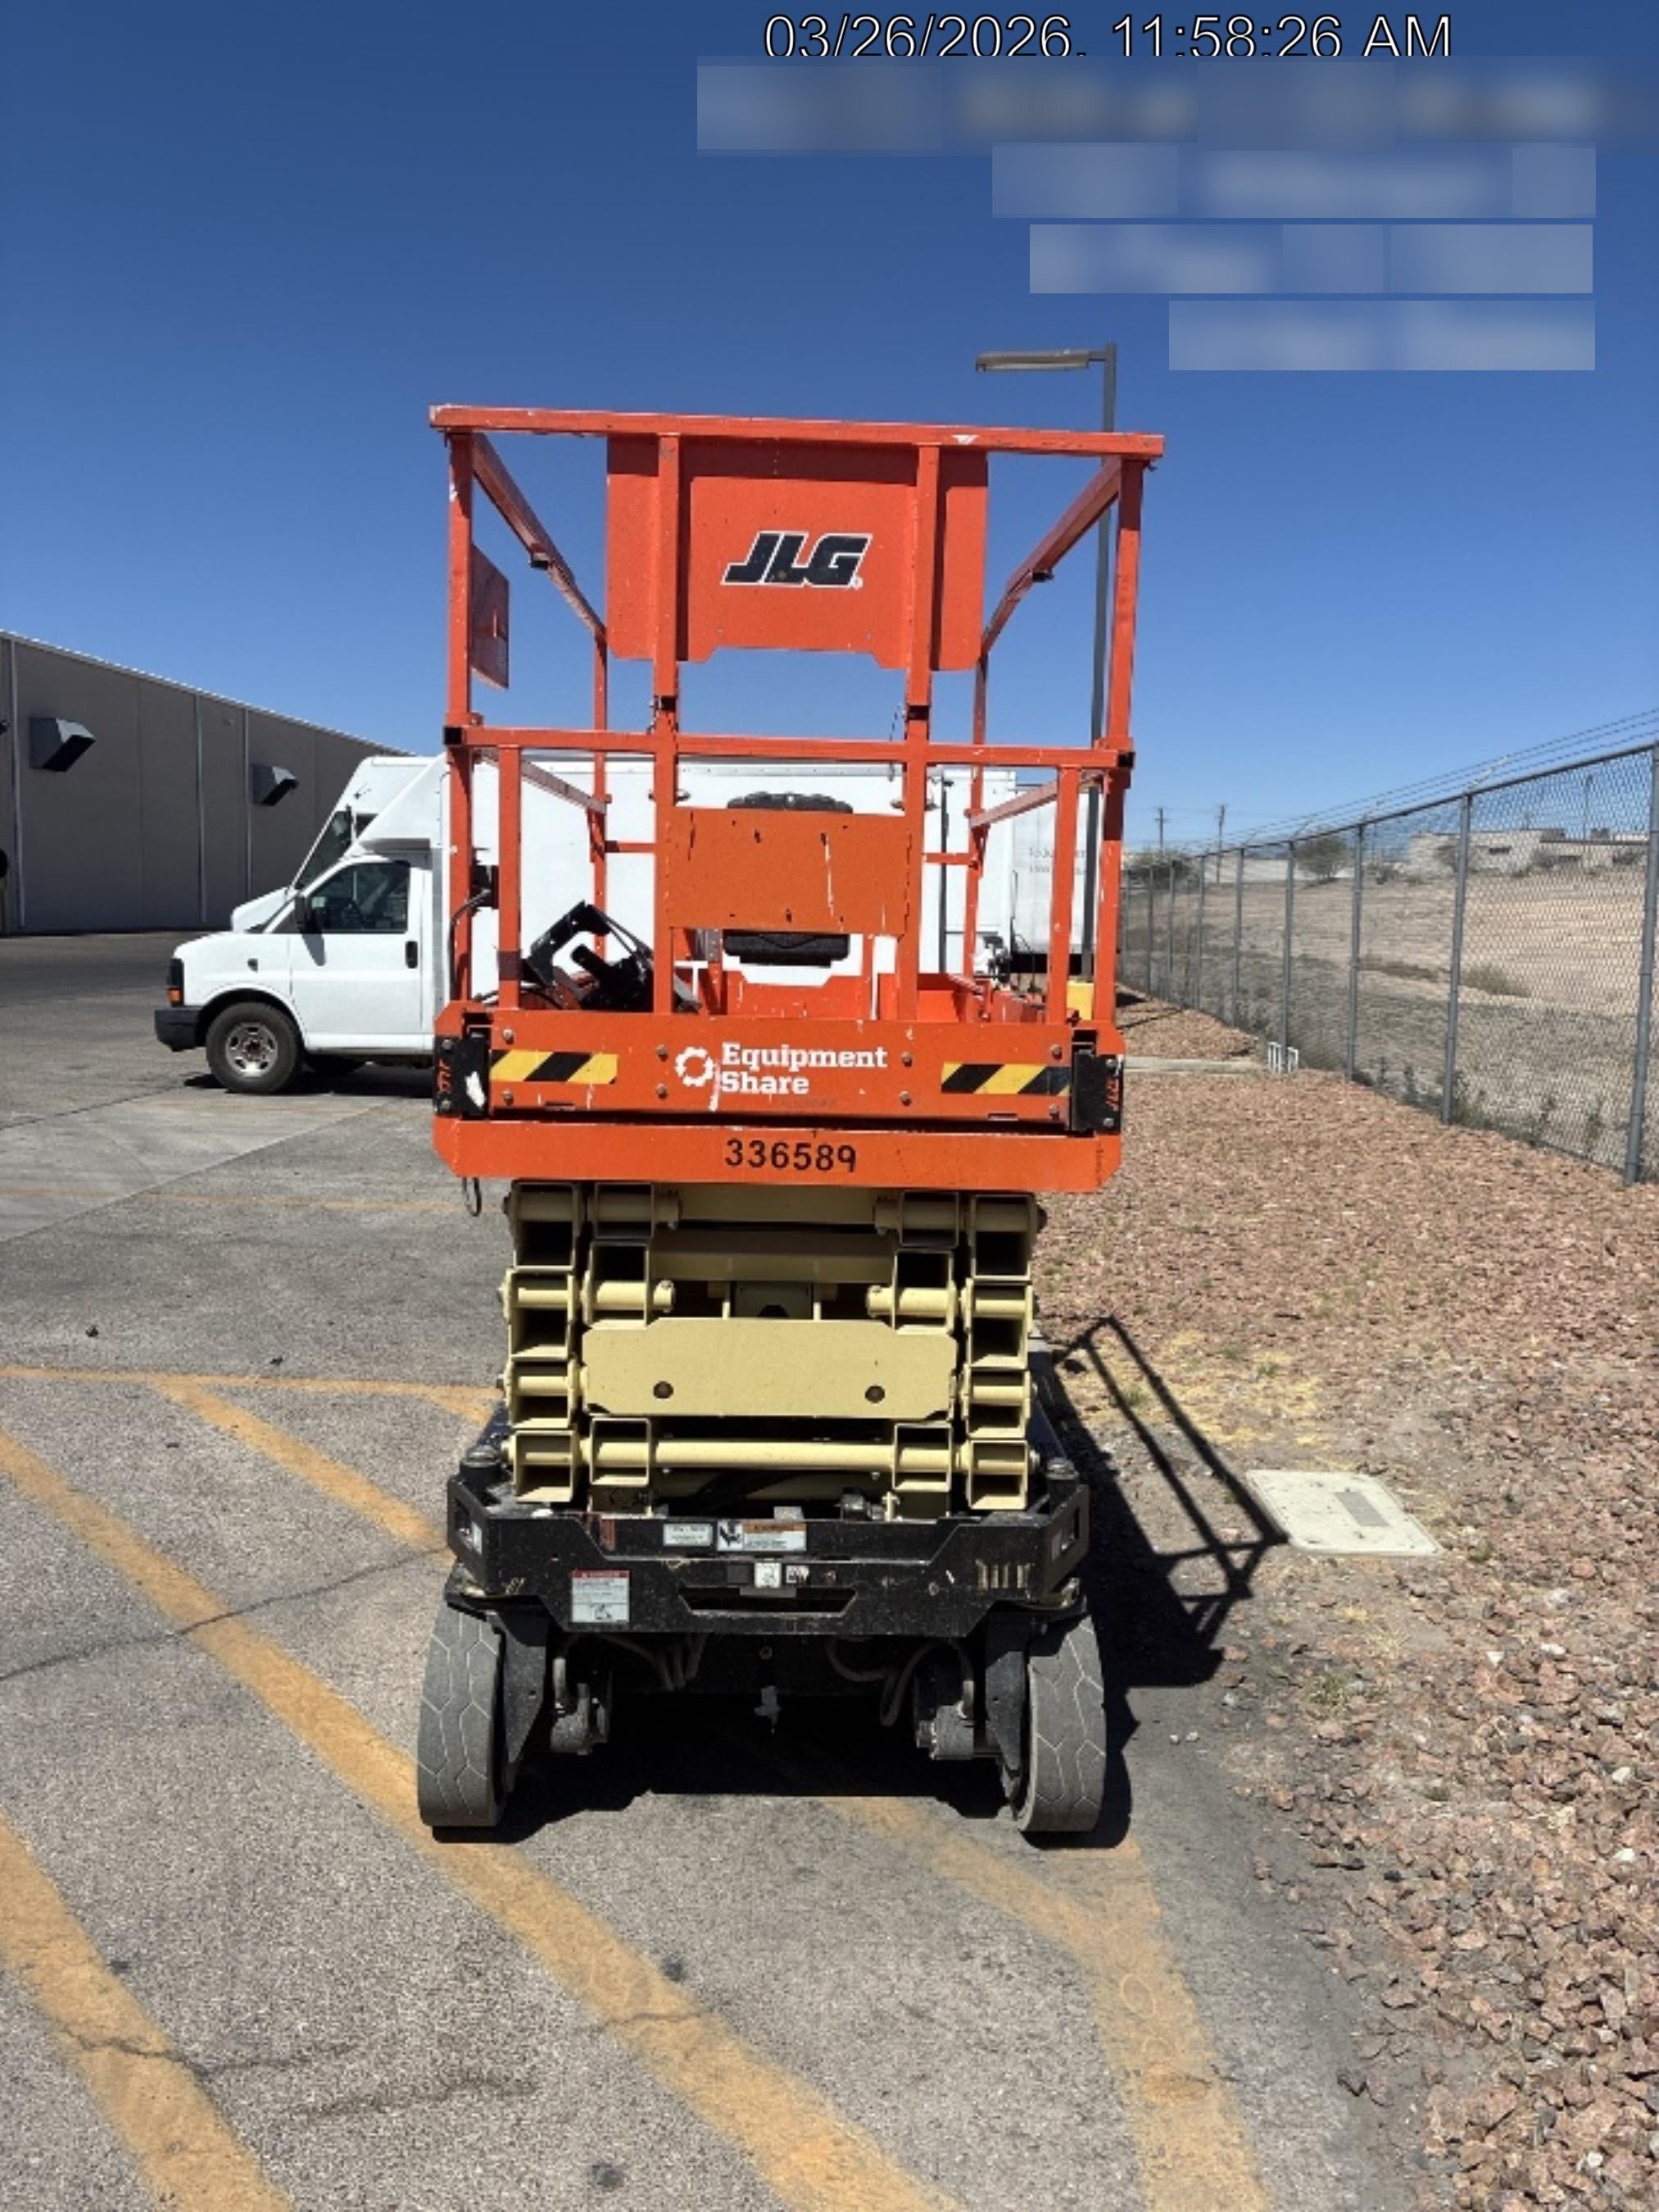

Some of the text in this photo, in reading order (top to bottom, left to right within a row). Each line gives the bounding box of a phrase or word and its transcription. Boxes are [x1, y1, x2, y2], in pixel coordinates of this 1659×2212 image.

[720, 531, 873, 587] JLG
[722, 1042, 887, 1072] Equipment
[721, 1071, 809, 1095] Share
[725, 1139, 856, 1172] 336589
